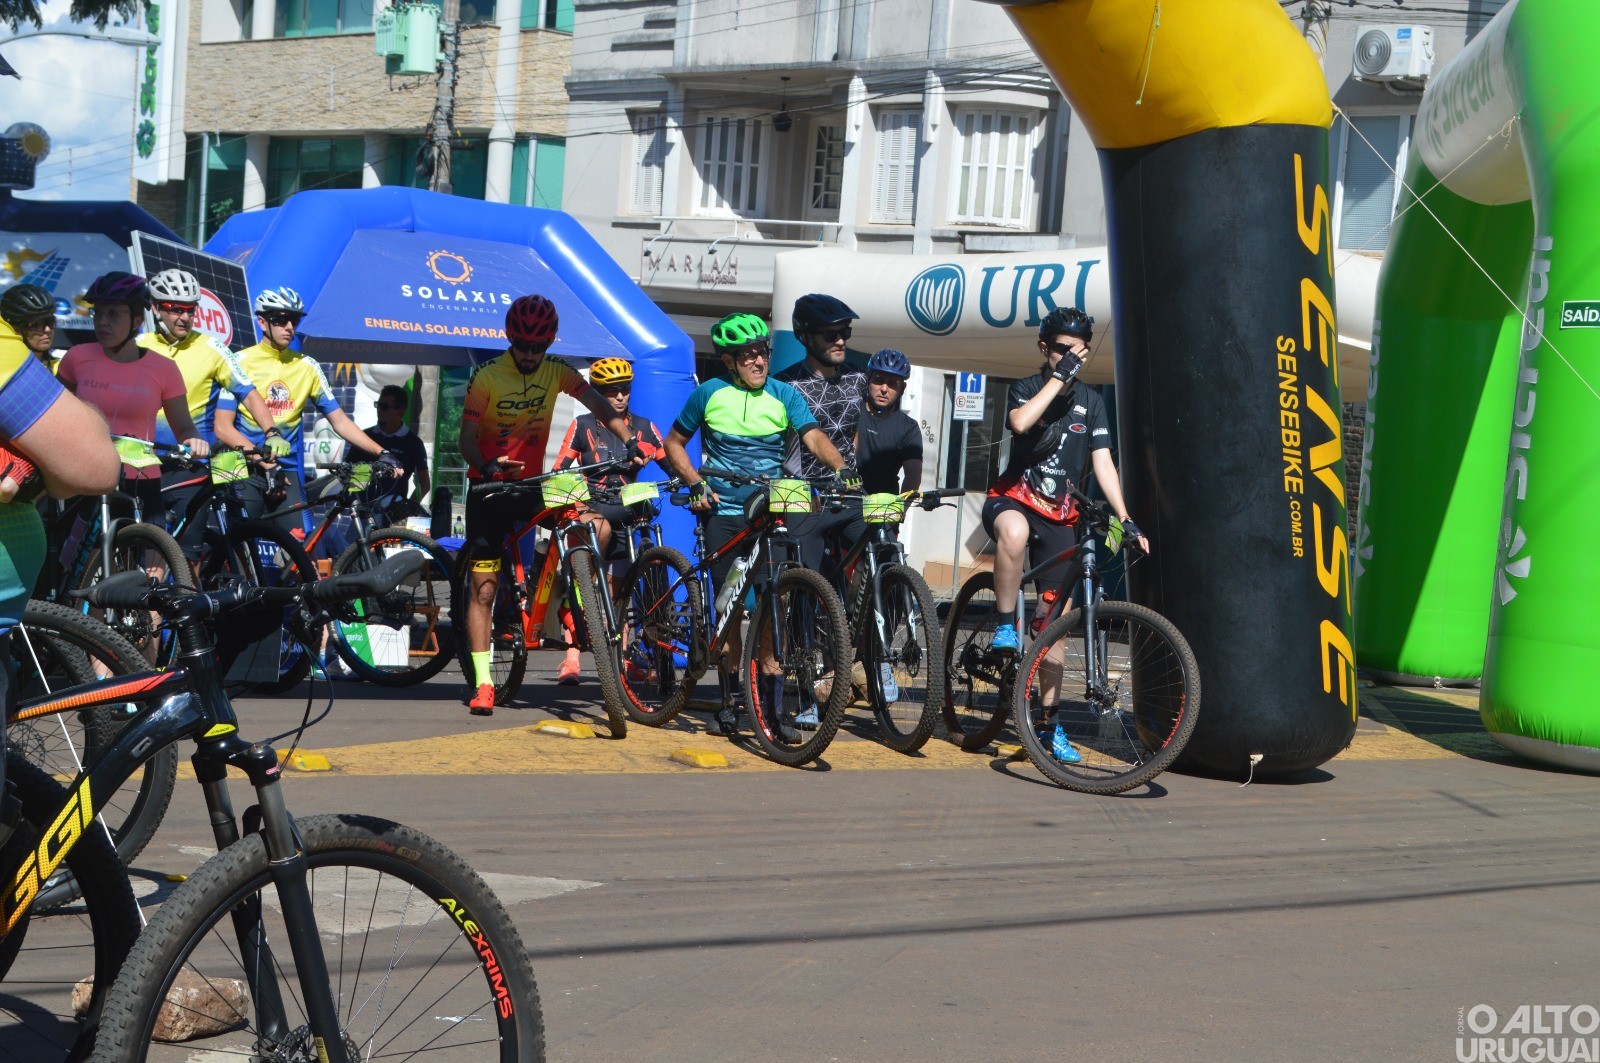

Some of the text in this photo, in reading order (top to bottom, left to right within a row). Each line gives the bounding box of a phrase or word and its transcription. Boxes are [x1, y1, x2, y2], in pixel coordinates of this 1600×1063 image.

[648, 253, 738, 275] MARIAH
[401, 284, 512, 305] SOLAXIS
[980, 259, 1101, 328] URI
[421, 302, 498, 314] ENGENHARIA
[1563, 306, 1600, 322] SAÍD
[364, 317, 508, 339] ENERGIA SOLAR PARA
[921, 419, 935, 444] 936
[1293, 153, 1355, 723] SENSE
[439, 898, 513, 1019] ALEXRIMS
